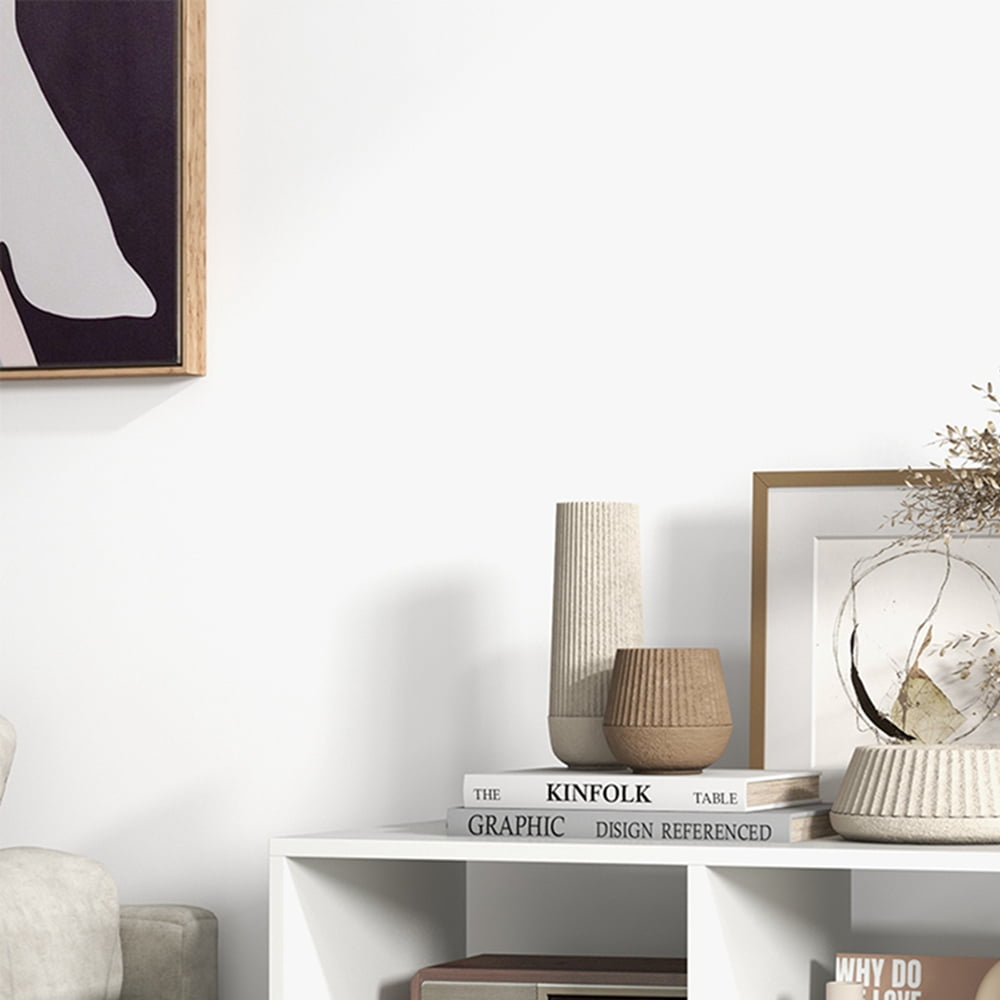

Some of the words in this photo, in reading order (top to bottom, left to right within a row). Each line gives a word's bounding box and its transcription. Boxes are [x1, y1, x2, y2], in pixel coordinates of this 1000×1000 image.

[473, 788, 501, 801] THE
[546, 783, 652, 804] KINFOLK
[692, 791, 738, 805] TABLE
[468, 813, 565, 838] GRAPHIC
[595, 820, 655, 839] DISIGN
[661, 822, 772, 842] REFERENCED
[836, 957, 885, 987] WHY
[891, 958, 922, 989] DO
